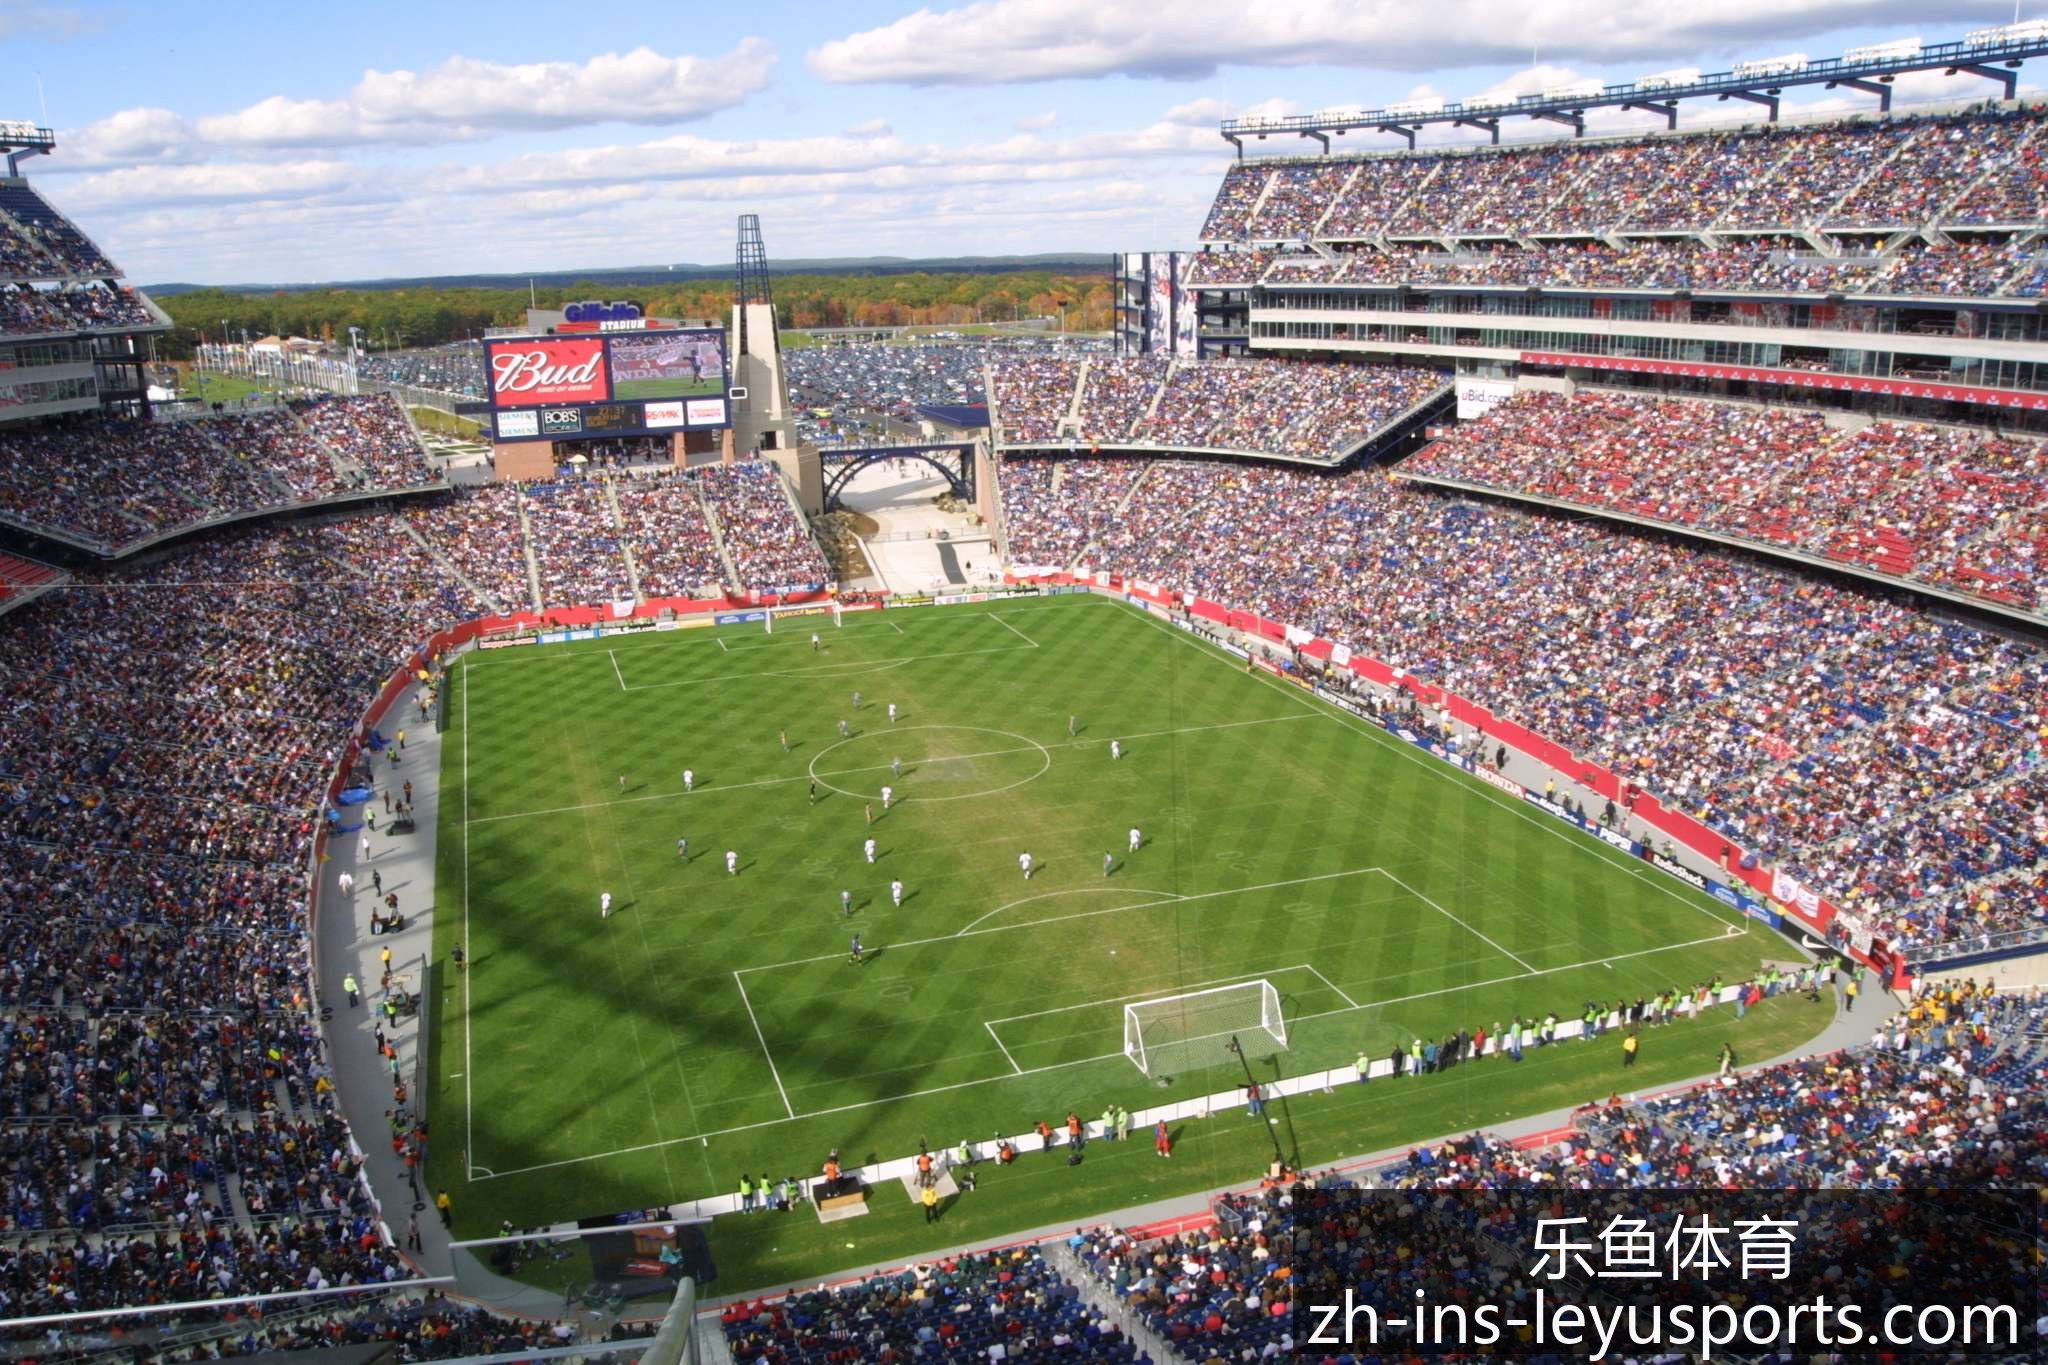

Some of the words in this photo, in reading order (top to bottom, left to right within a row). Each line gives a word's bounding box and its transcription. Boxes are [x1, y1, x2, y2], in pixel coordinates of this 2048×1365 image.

[600, 319, 646, 330] STADIUM
[492, 351, 603, 393] Bud
[545, 410, 578, 424] BOB'S
[499, 427, 538, 436] SIEMENS
[1475, 764, 1525, 799] HONDA
[1600, 827, 1632, 851] PEPSI
